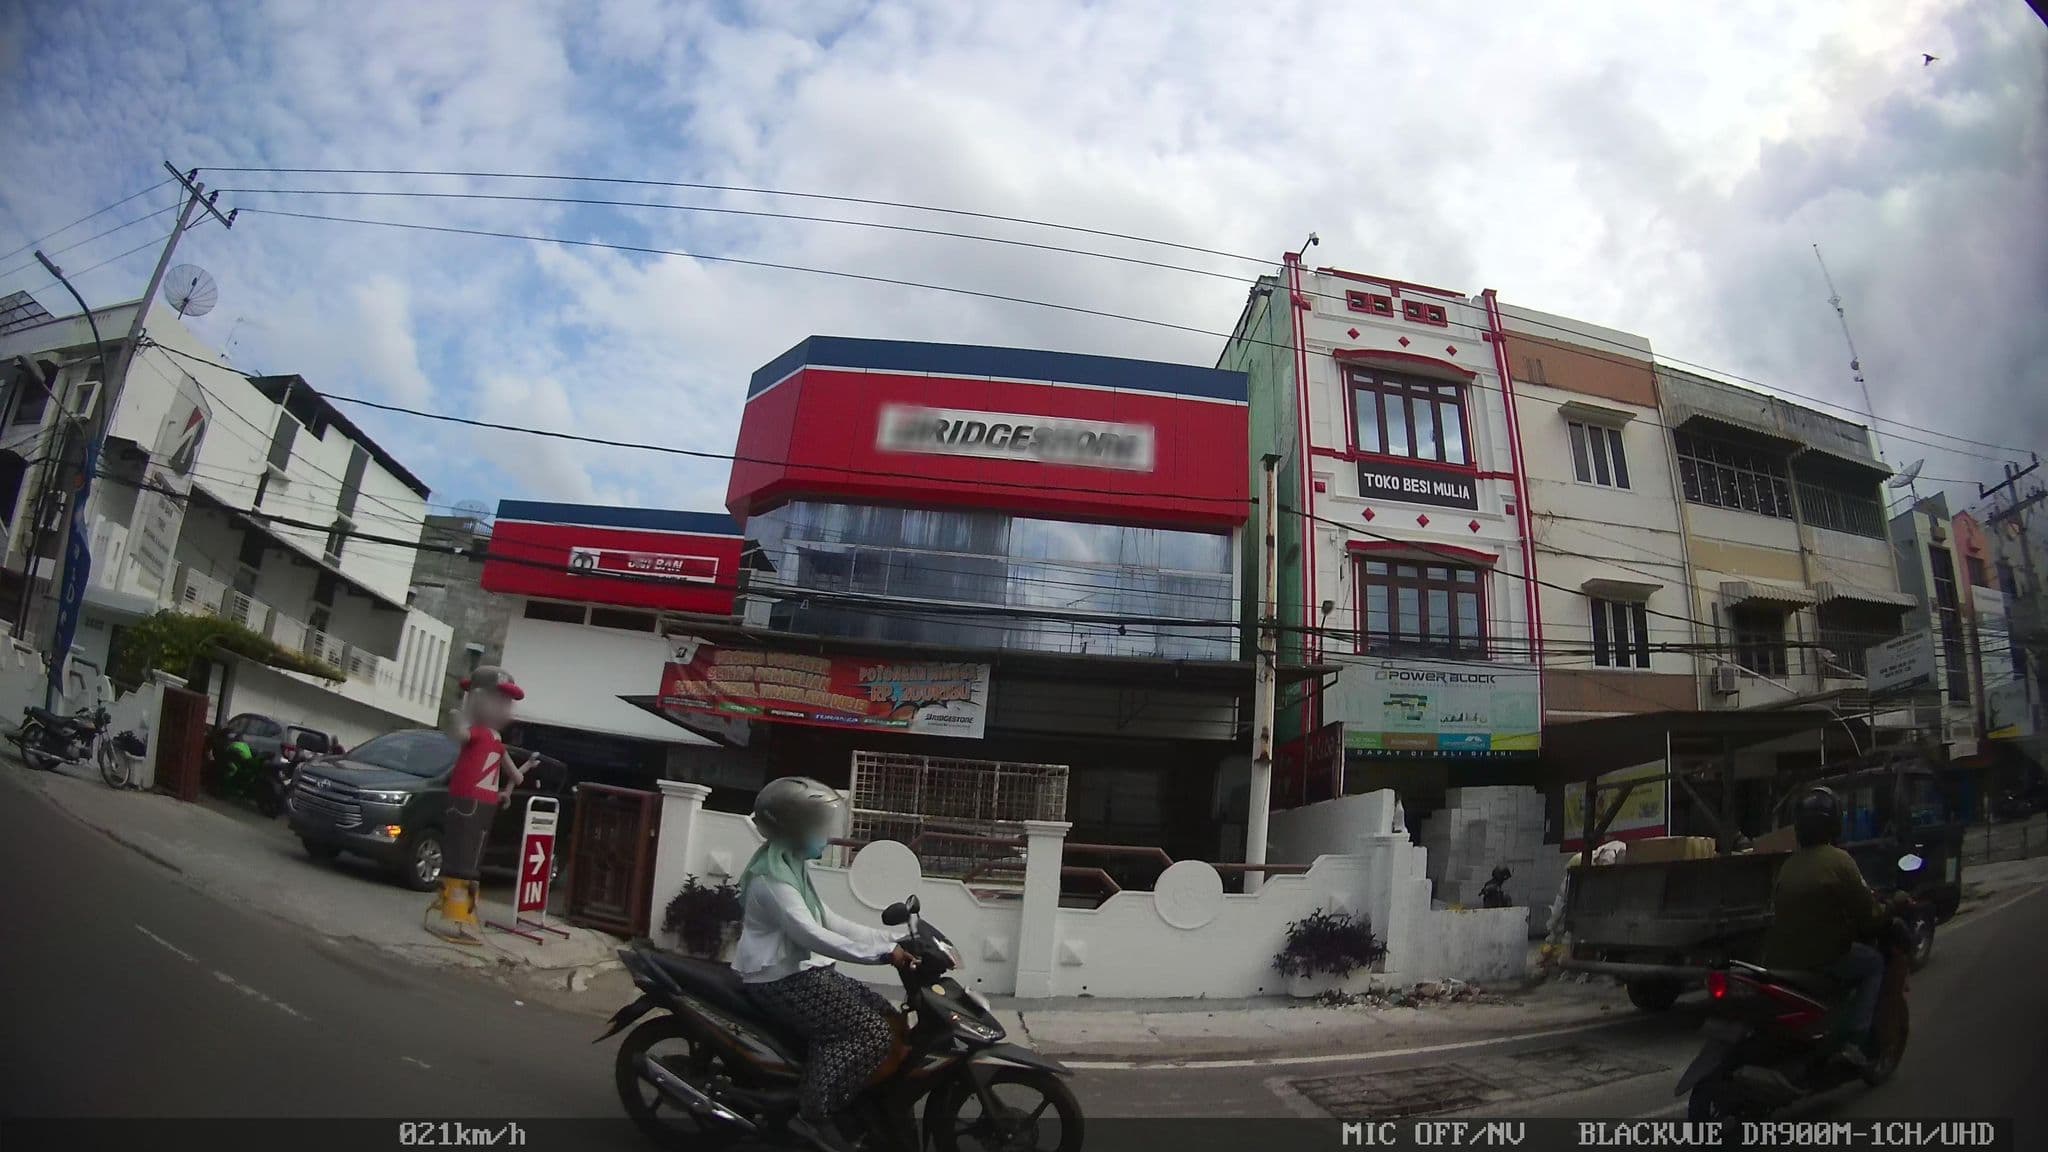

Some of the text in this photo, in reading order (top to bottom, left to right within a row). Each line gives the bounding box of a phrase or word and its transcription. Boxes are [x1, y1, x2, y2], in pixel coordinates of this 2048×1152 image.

[1364, 473, 1470, 500] TOKO BESI MULIA
[1450, 674, 1496, 684] BLOCK
[924, 713, 975, 725] BRIDGESTONE
[523, 881, 543, 904] IN
